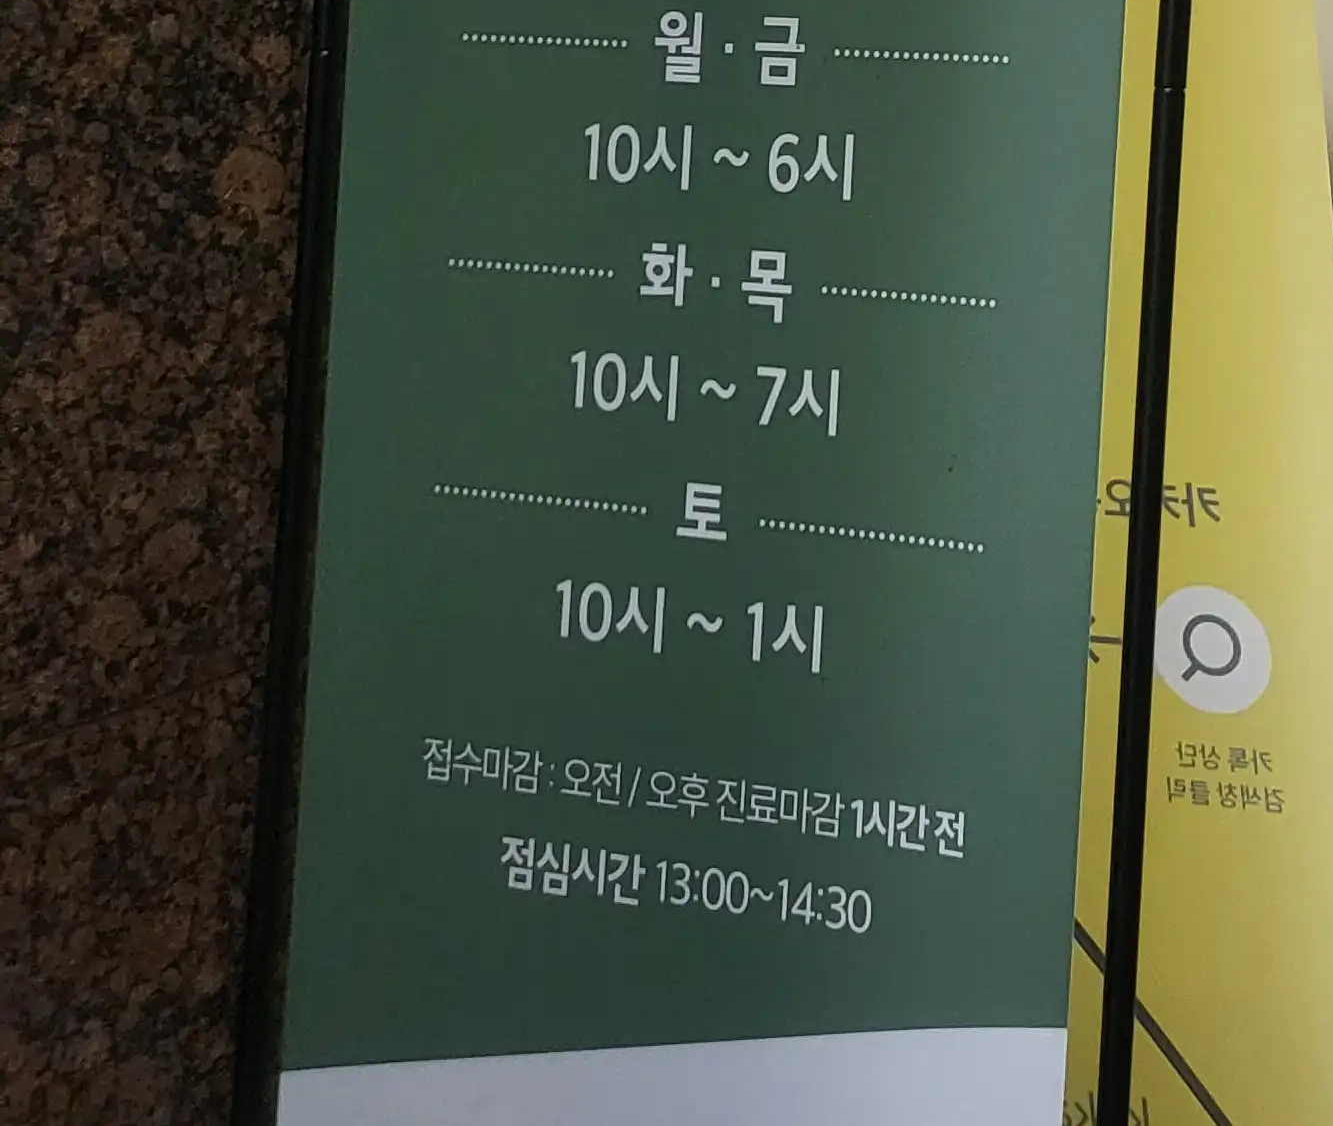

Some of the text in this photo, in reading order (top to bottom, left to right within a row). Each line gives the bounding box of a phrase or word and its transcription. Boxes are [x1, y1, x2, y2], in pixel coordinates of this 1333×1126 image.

[655, 12, 805, 85] 월 금
[585, 124, 692, 190] 10시
[769, 134, 854, 200] 6시
[640, 243, 792, 323] 화 목
[571, 351, 678, 421] 10시
[757, 367, 839, 436] 7시
[677, 483, 727, 540] 토
[557, 580, 665, 653] 10시
[748, 602, 823, 673] 1시
[561, 760, 622, 805] 오전
[646, 772, 709, 814] 오후
[717, 780, 844, 838] 진료마감
[851, 800, 930, 851] 1시간
[935, 811, 964, 858] 전
[501, 837, 871, 933] 점심시간 13:00~14:30
